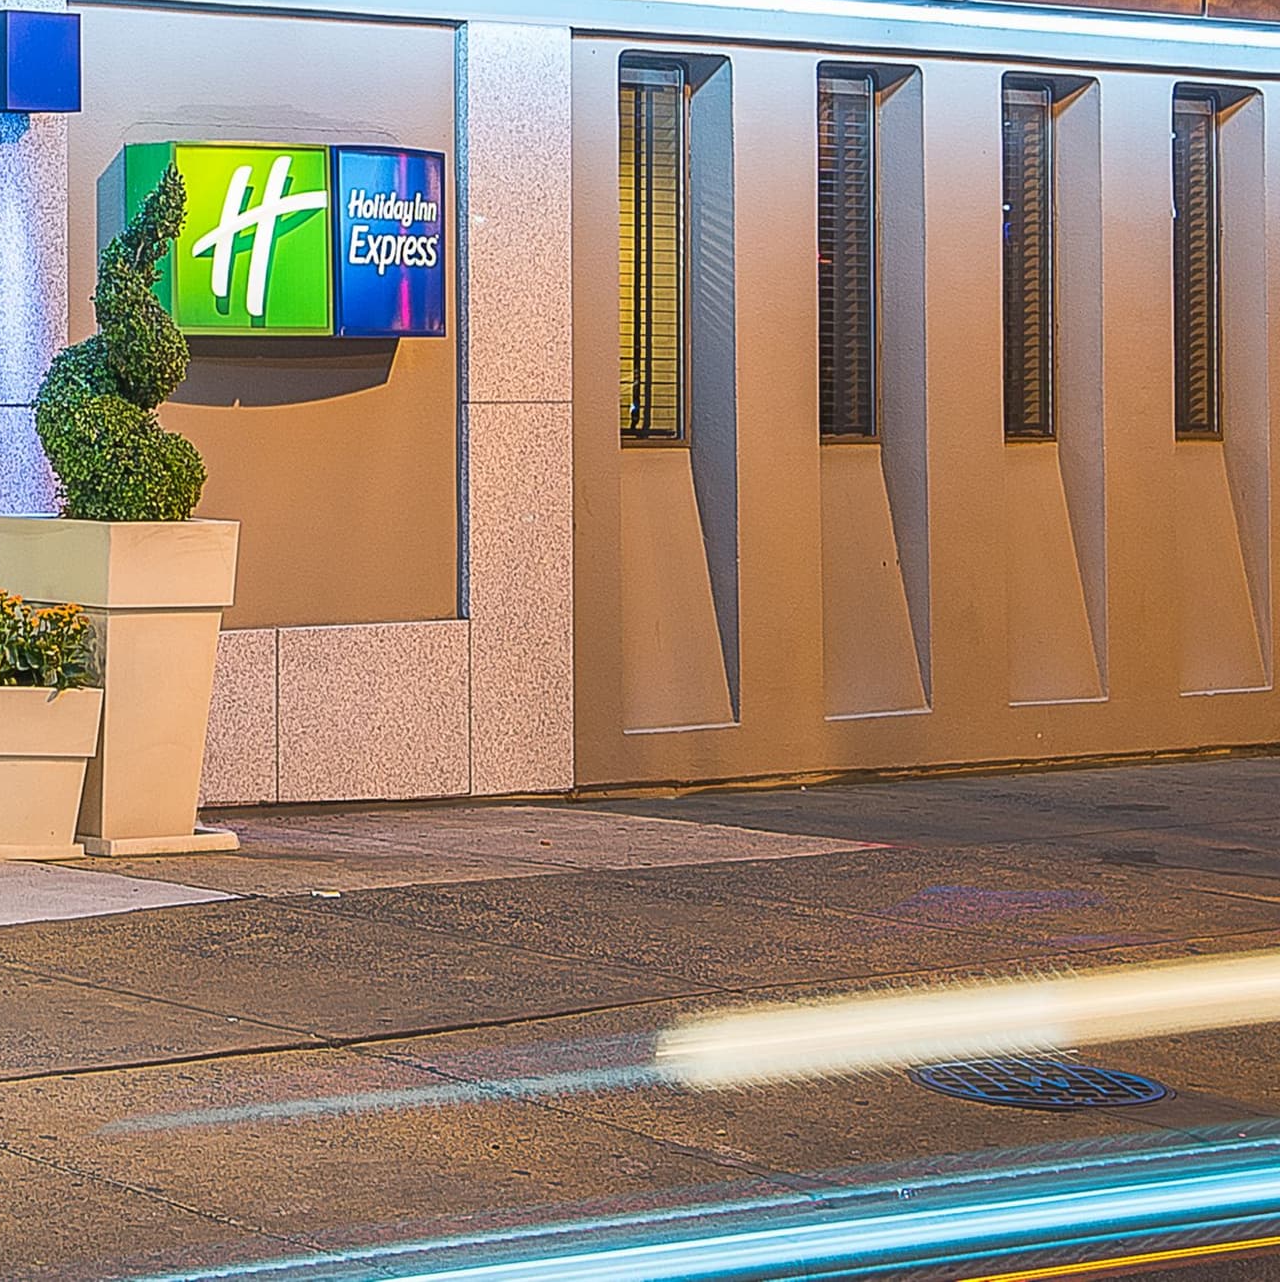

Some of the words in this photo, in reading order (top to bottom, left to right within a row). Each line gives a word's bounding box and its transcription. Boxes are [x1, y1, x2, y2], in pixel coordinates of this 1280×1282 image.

[348, 188, 414, 227] Holiday
[414, 192, 437, 221] Inn
[191, 155, 328, 317] H
[349, 225, 437, 275] Express
